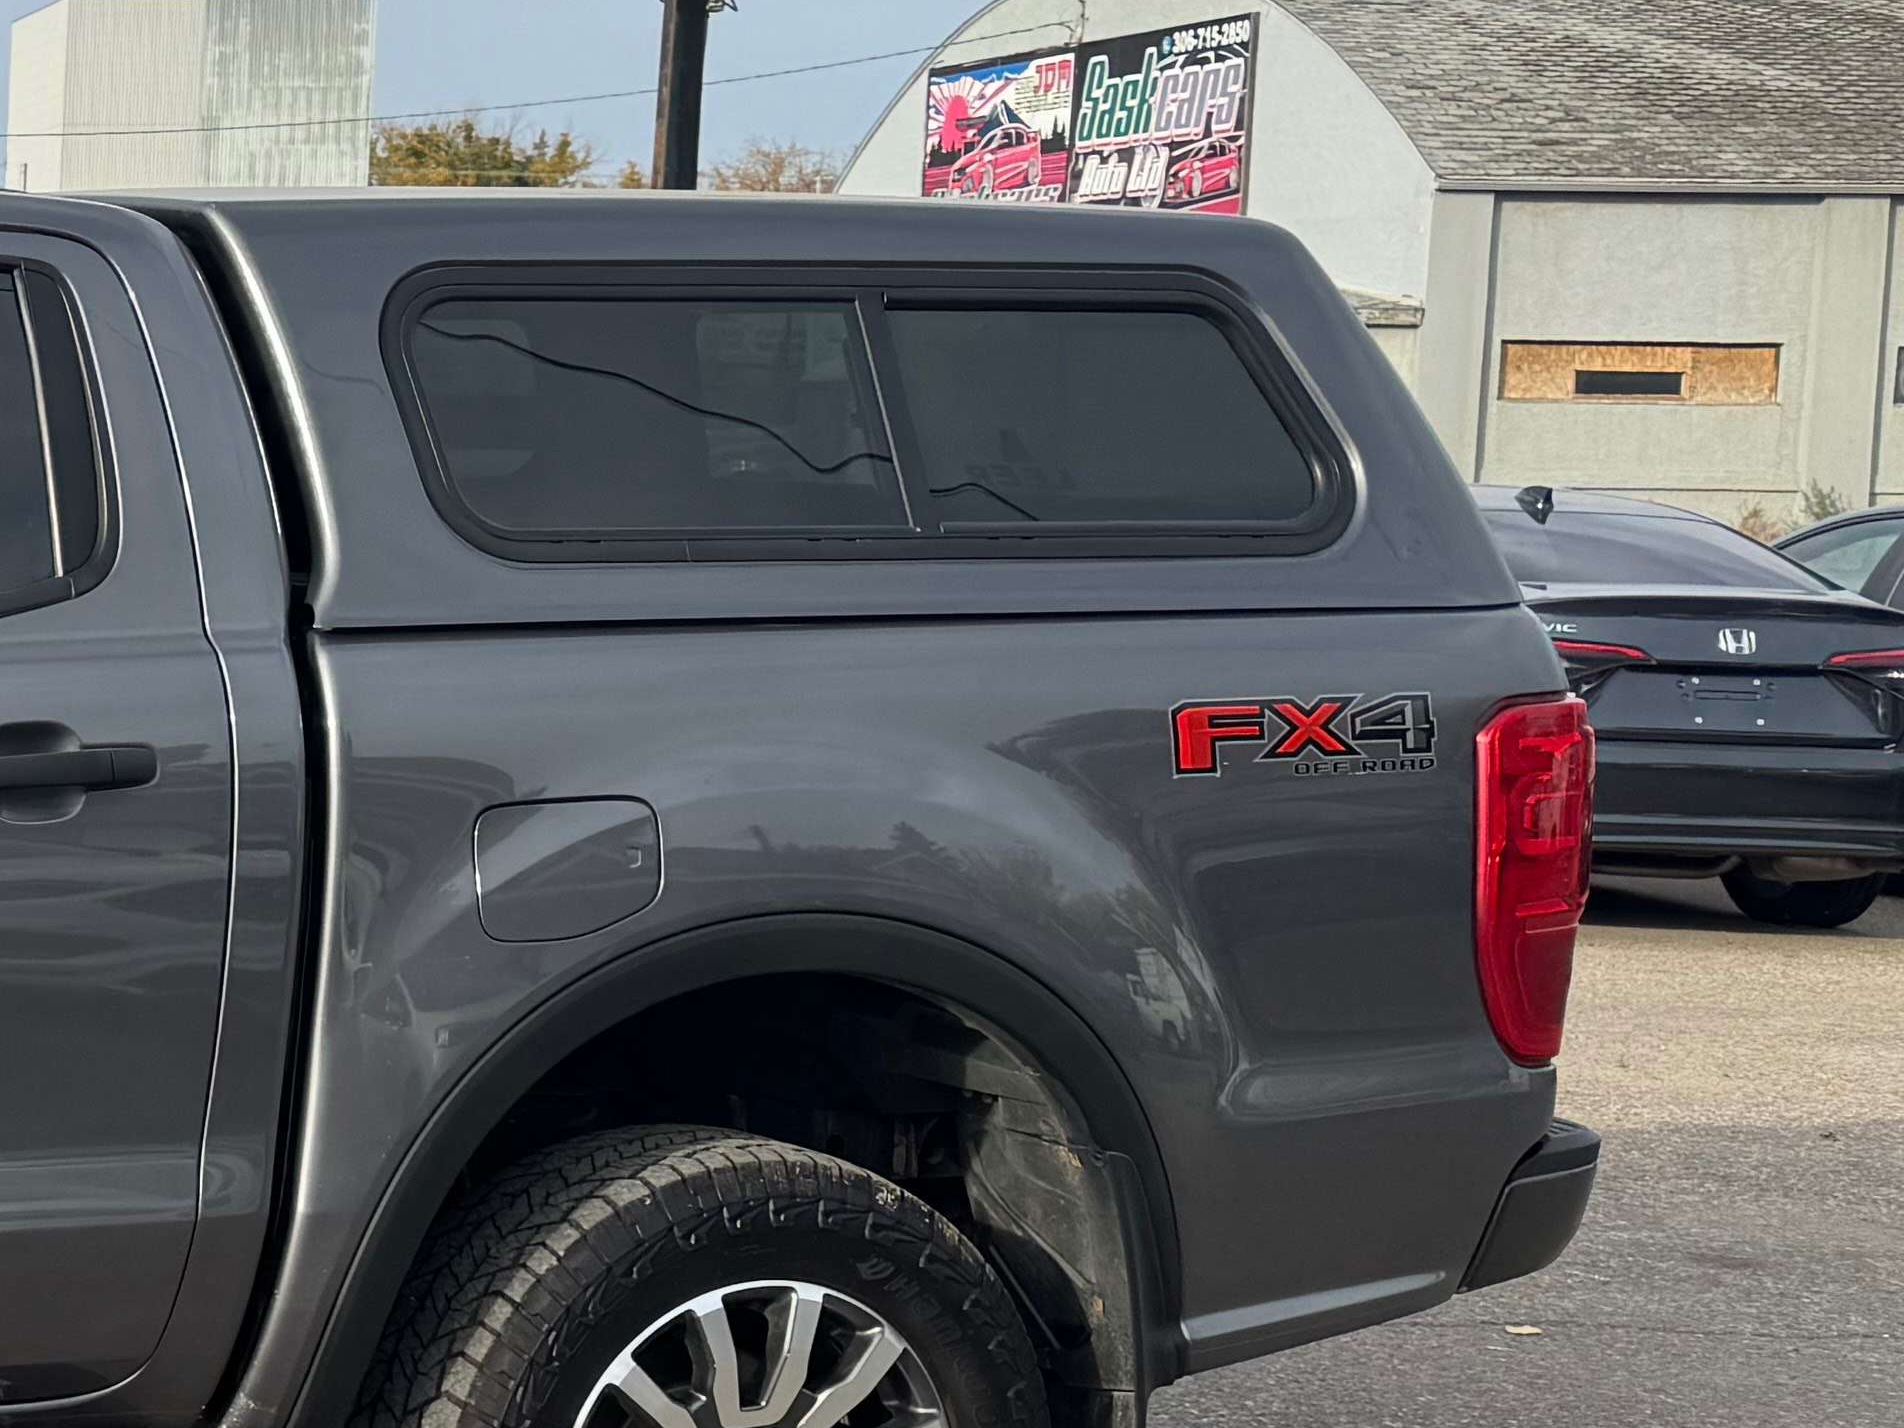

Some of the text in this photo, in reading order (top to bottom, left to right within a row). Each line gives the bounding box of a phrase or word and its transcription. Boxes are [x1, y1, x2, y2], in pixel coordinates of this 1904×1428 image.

[1542, 623, 1577, 632] VIC
[1168, 692, 1436, 778] FX4
[1294, 757, 1436, 776] OFF ROAD
